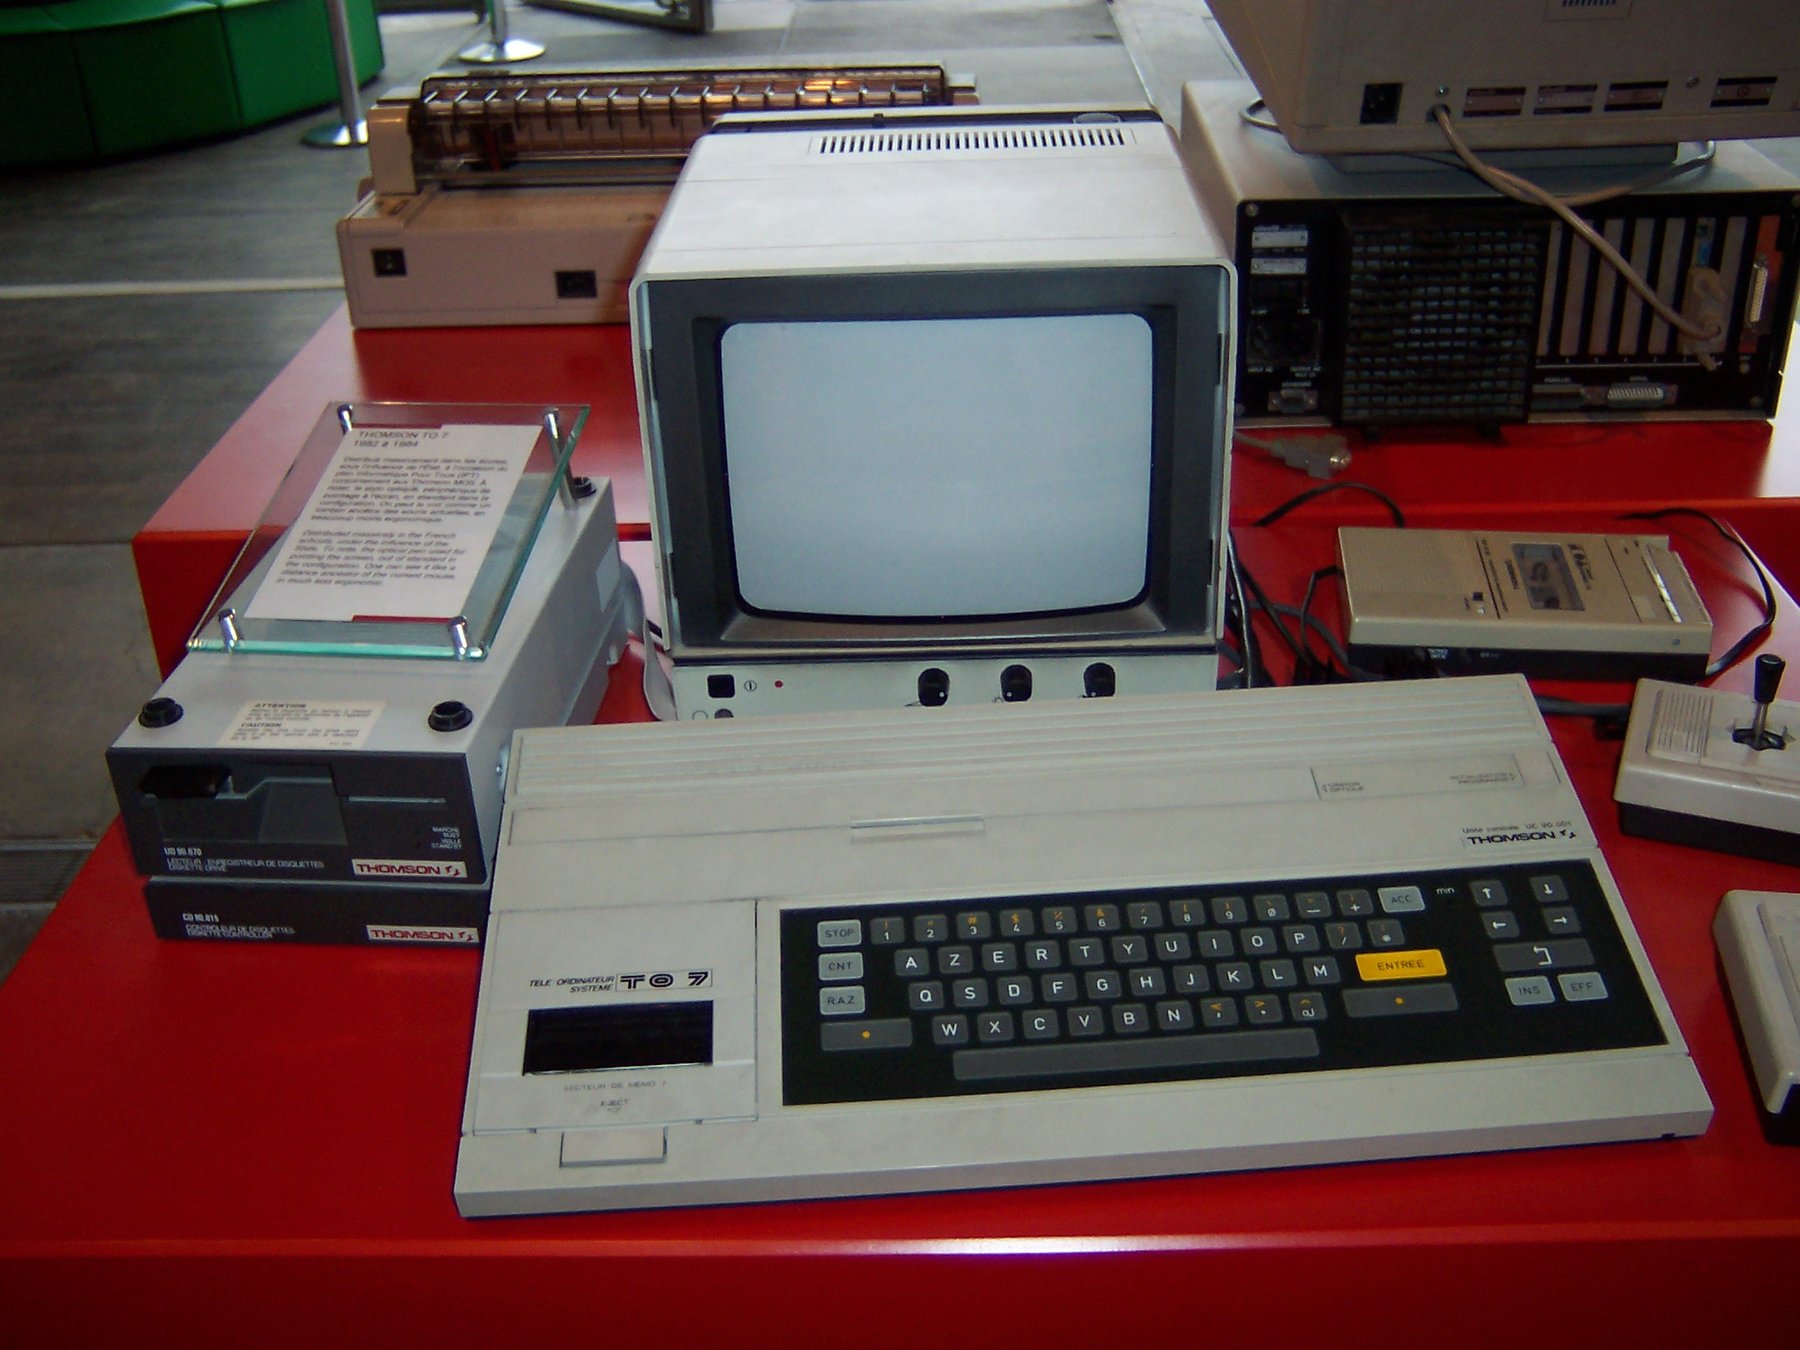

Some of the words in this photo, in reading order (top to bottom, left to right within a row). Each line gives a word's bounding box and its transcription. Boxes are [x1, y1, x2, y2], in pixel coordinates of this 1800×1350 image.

[359, 430, 418, 439] THOMSON
[1467, 831, 1556, 845] THOMSON
[356, 864, 440, 874] THOMSON
[1436, 887, 1456, 895] min
[1391, 894, 1412, 904] ACC
[1140, 916, 1148, 924] 7
[1184, 914, 1190, 922] 8
[1226, 910, 1234, 920] 9
[1056, 922, 1064, 930] 5
[1098, 918, 1106, 926] 6
[825, 928, 856, 938] STOP
[970, 926, 978, 934] 3
[1014, 924, 1020, 932] 4
[371, 929, 454, 940] THOMSON
[884, 932, 890, 940] 1
[926, 930, 934, 938] 2
[1294, 933, 1304, 944] P
[1166, 941, 1177, 952] U
[1252, 936, 1263, 947] O
[1037, 949, 1047, 960] R
[1080, 946, 1089, 957] T
[1123, 944, 1132, 954] Y
[906, 957, 917, 968] A
[950, 954, 959, 965] Z
[993, 951, 1004, 963] E
[828, 961, 853, 971] CNT
[1314, 965, 1327, 976] M
[1376, 960, 1424, 971] ENTREE
[1187, 974, 1194, 985] J
[1228, 971, 1239, 982] K
[1272, 969, 1283, 979] L
[530, 979, 552, 987] TELE
[556, 976, 614, 986] ORDINATEUR
[620, 973, 674, 990] TO
[688, 972, 708, 986] 7
[1097, 979, 1108, 990] G
[1141, 977, 1152, 987] H
[570, 984, 612, 993] SYSTEME
[1009, 985, 1020, 996] D
[1053, 982, 1062, 993] F
[1519, 985, 1540, 996] INS
[1571, 982, 1592, 992] EFF
[920, 990, 932, 1001] Q
[965, 987, 975, 999] S
[826, 995, 856, 1006] RAZ
[1124, 1012, 1134, 1024] B
[1168, 1009, 1179, 1021] N
[1035, 1018, 1045, 1030] C
[1079, 1015, 1089, 1027] V
[942, 1024, 957, 1035] W
[990, 1021, 1000, 1033] X
[564, 1084, 606, 1092] LECTEUR
[628, 1080, 656, 1088] MEMO
